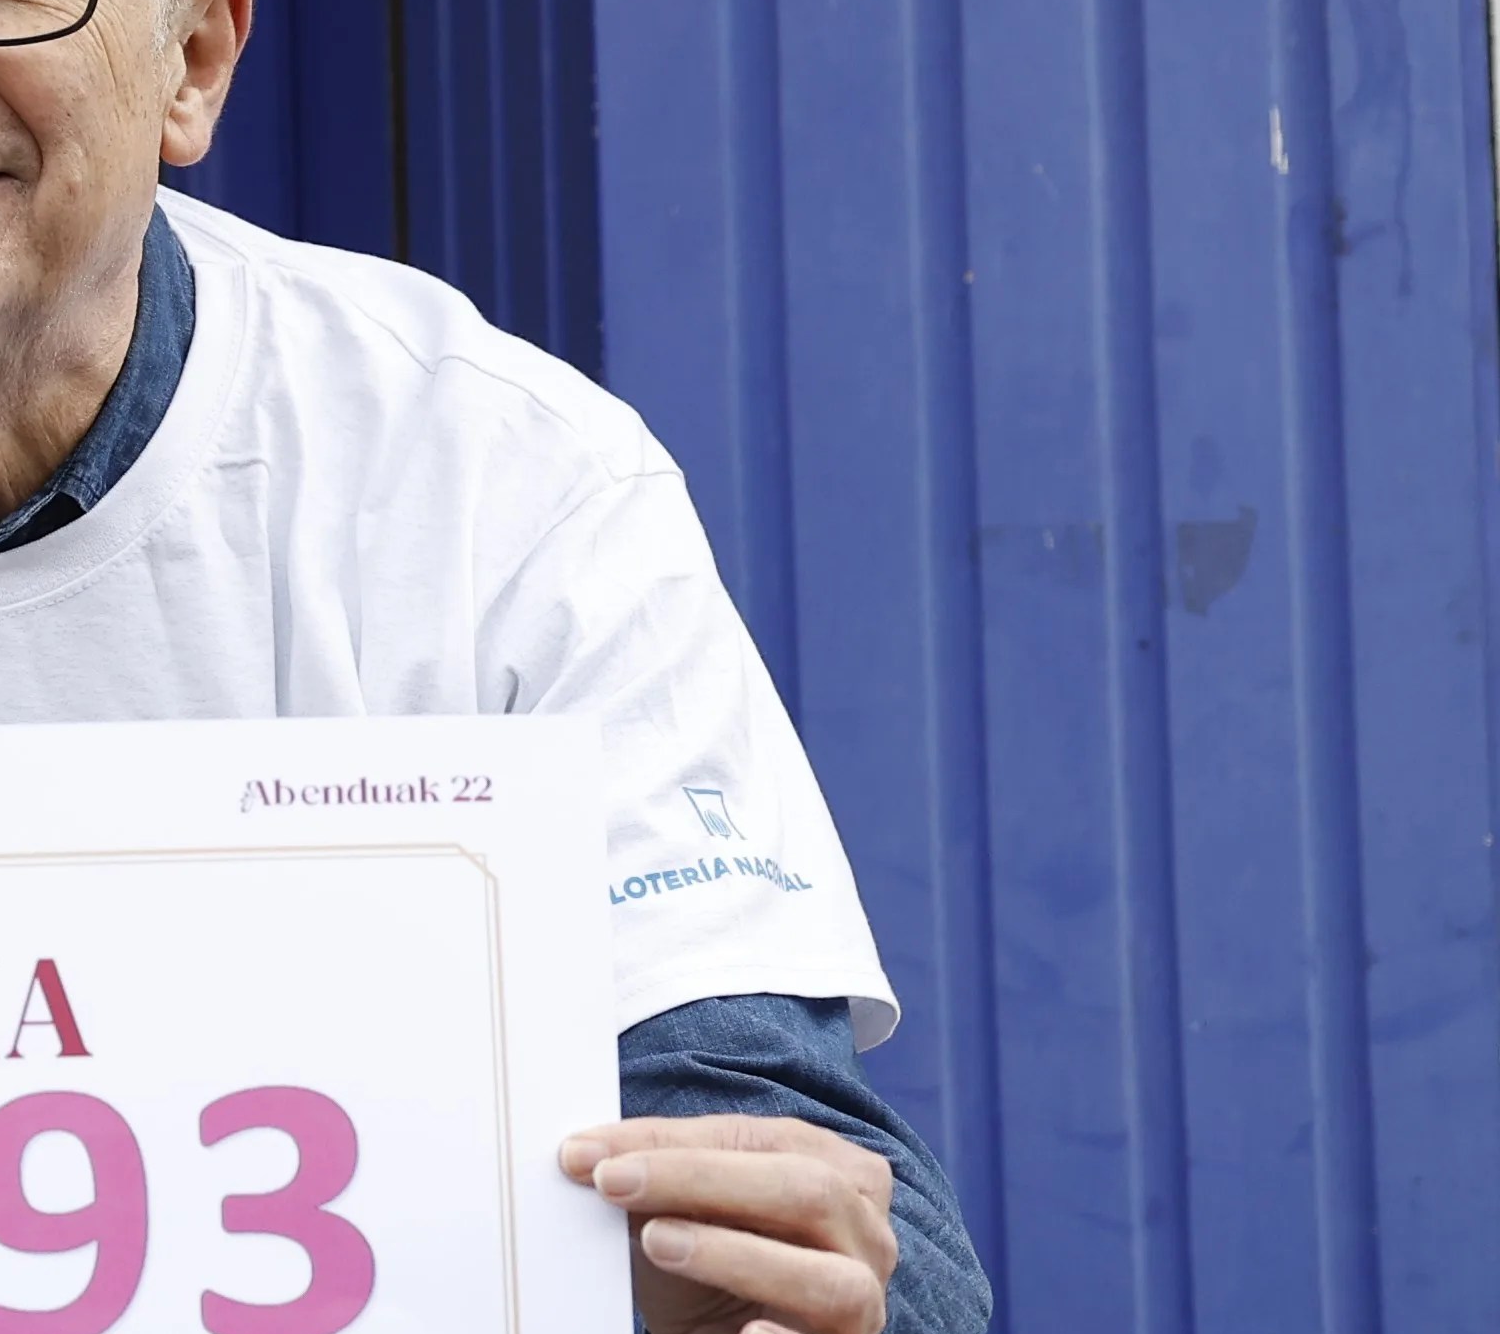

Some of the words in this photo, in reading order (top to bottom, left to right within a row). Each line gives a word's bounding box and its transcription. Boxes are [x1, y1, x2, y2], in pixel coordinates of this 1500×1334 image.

[241, 776, 440, 813] Abenduak
[451, 776, 493, 803] 22
[609, 857, 732, 905] LOTERÍA
